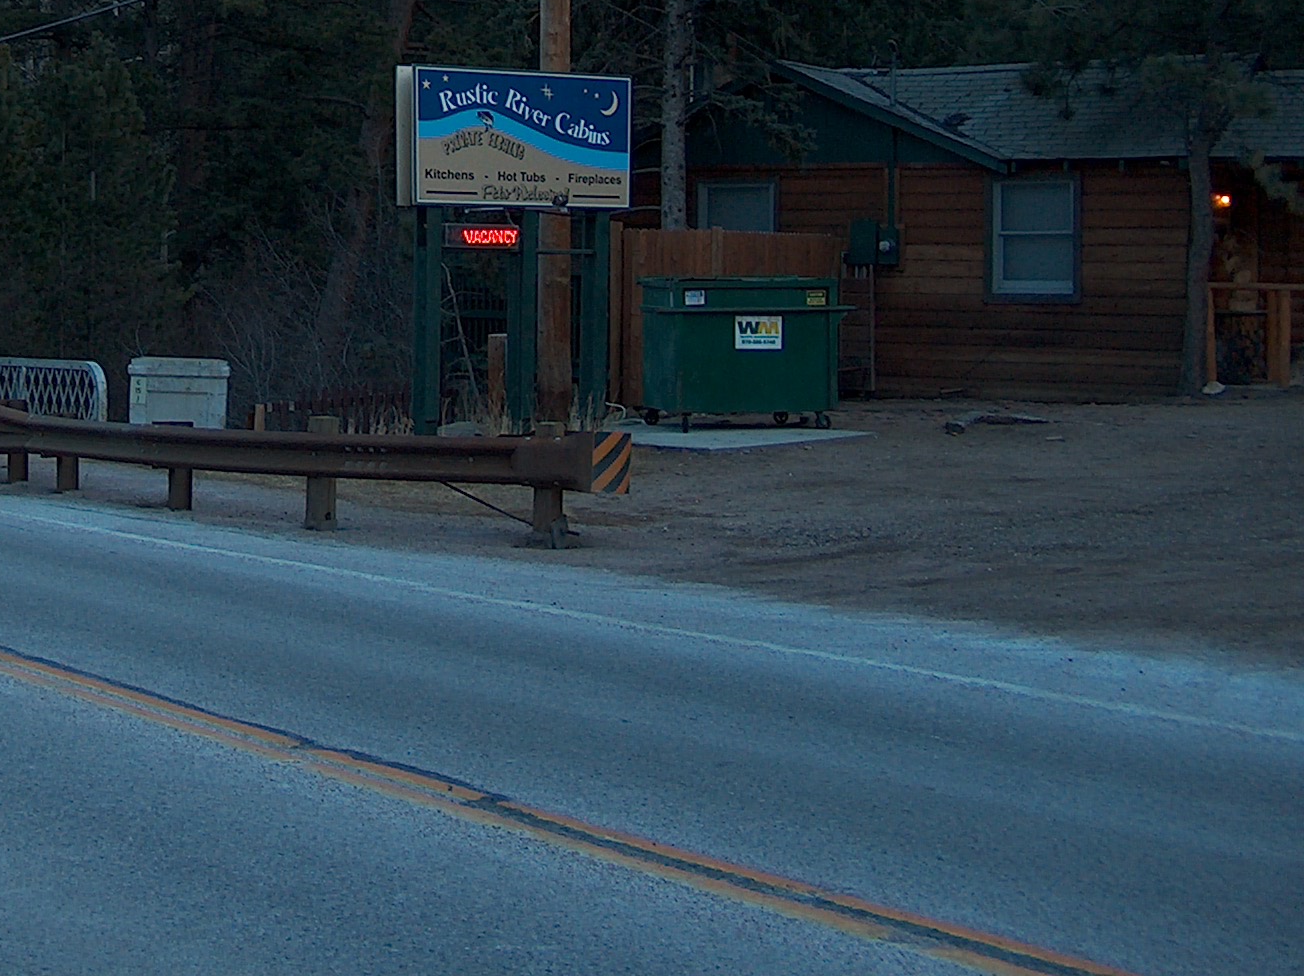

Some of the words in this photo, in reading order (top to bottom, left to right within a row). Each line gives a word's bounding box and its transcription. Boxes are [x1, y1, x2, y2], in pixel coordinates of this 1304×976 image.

[439, 83, 499, 113] Rustic
[505, 88, 551, 127] River
[555, 112, 611, 146] Cabins
[424, 168, 475, 181] Kitchens
[497, 171, 517, 182] Hot
[520, 171, 546, 183] Tubs
[568, 173, 622, 186] Fireplaces
[463, 229, 518, 244] VACANCY
[737, 320, 780, 335] WM
